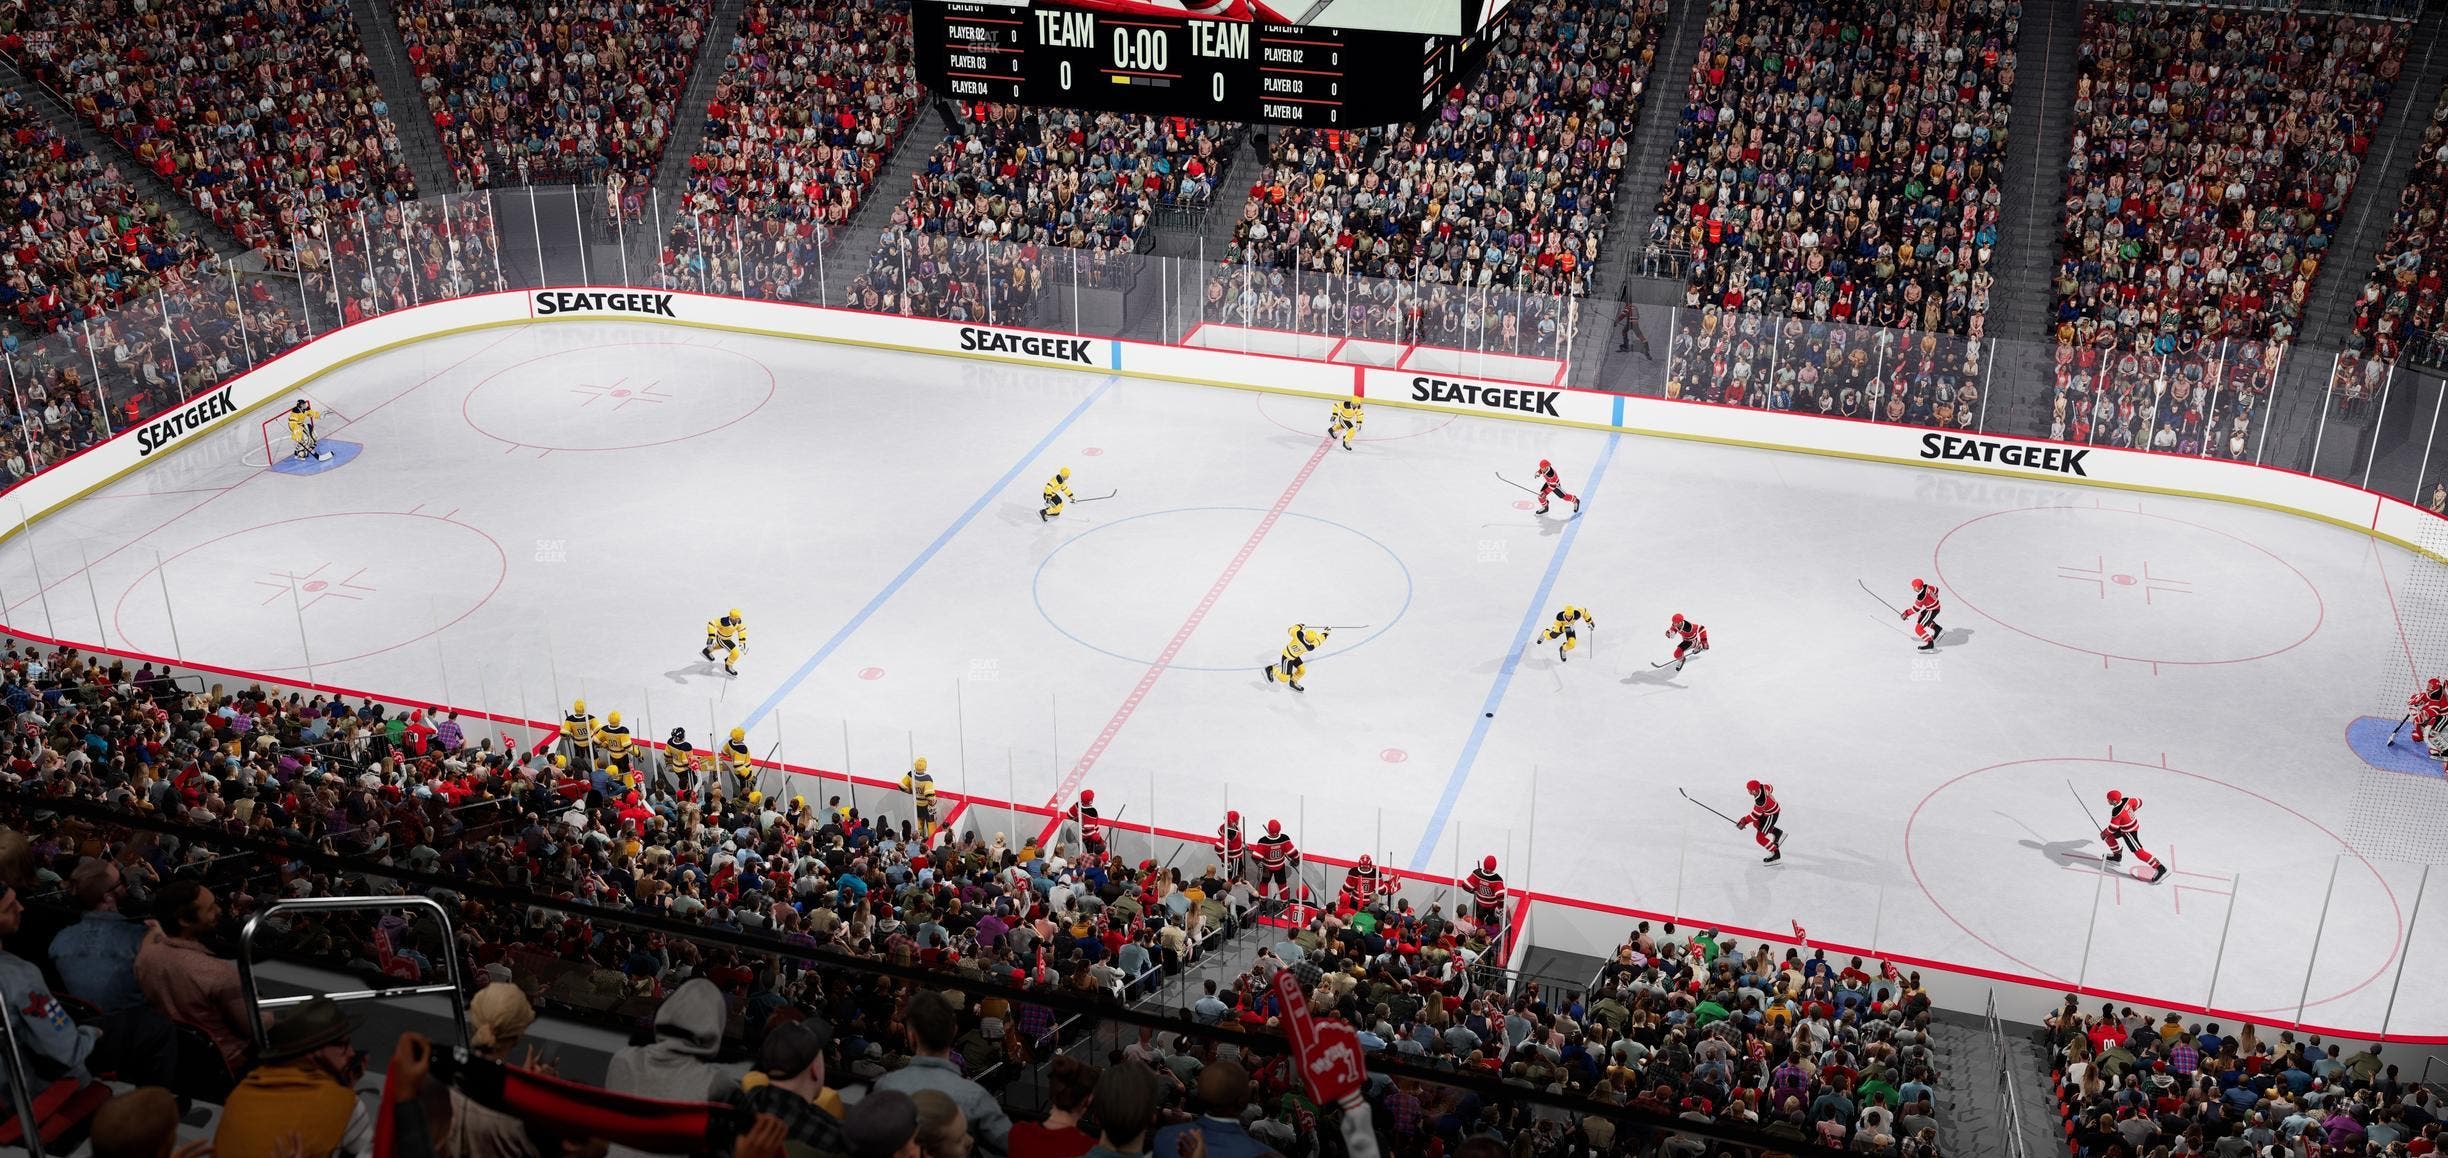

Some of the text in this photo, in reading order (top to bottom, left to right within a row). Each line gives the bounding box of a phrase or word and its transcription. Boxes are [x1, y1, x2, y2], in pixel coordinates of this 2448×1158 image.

[949, 26, 1017, 43] PLAYER 02 0
[1035, 10, 1095, 48] TEAM
[1188, 20, 1249, 60] TEAM
[951, 55, 1018, 71] PLAYER 03 0
[1114, 27, 1167, 71] 0:00
[1265, 48, 1338, 65] PLAYER 02 0
[952, 80, 1019, 97] PLAYER 04 0
[1060, 61, 1072, 90] 0
[1213, 72, 1225, 102] 0
[1264, 78, 1337, 96] PLAYER 03 0
[1264, 104, 1337, 122] PLAYER 04 0
[536, 292, 676, 317] SEATGEEK
[961, 328, 1093, 364] SEATGEEK
[1413, 378, 1560, 417] SEATGEEK
[138, 386, 237, 456] SEATGEEK
[1921, 434, 2090, 476] SEATGEEK
[1270, 850, 1281, 859] 00
